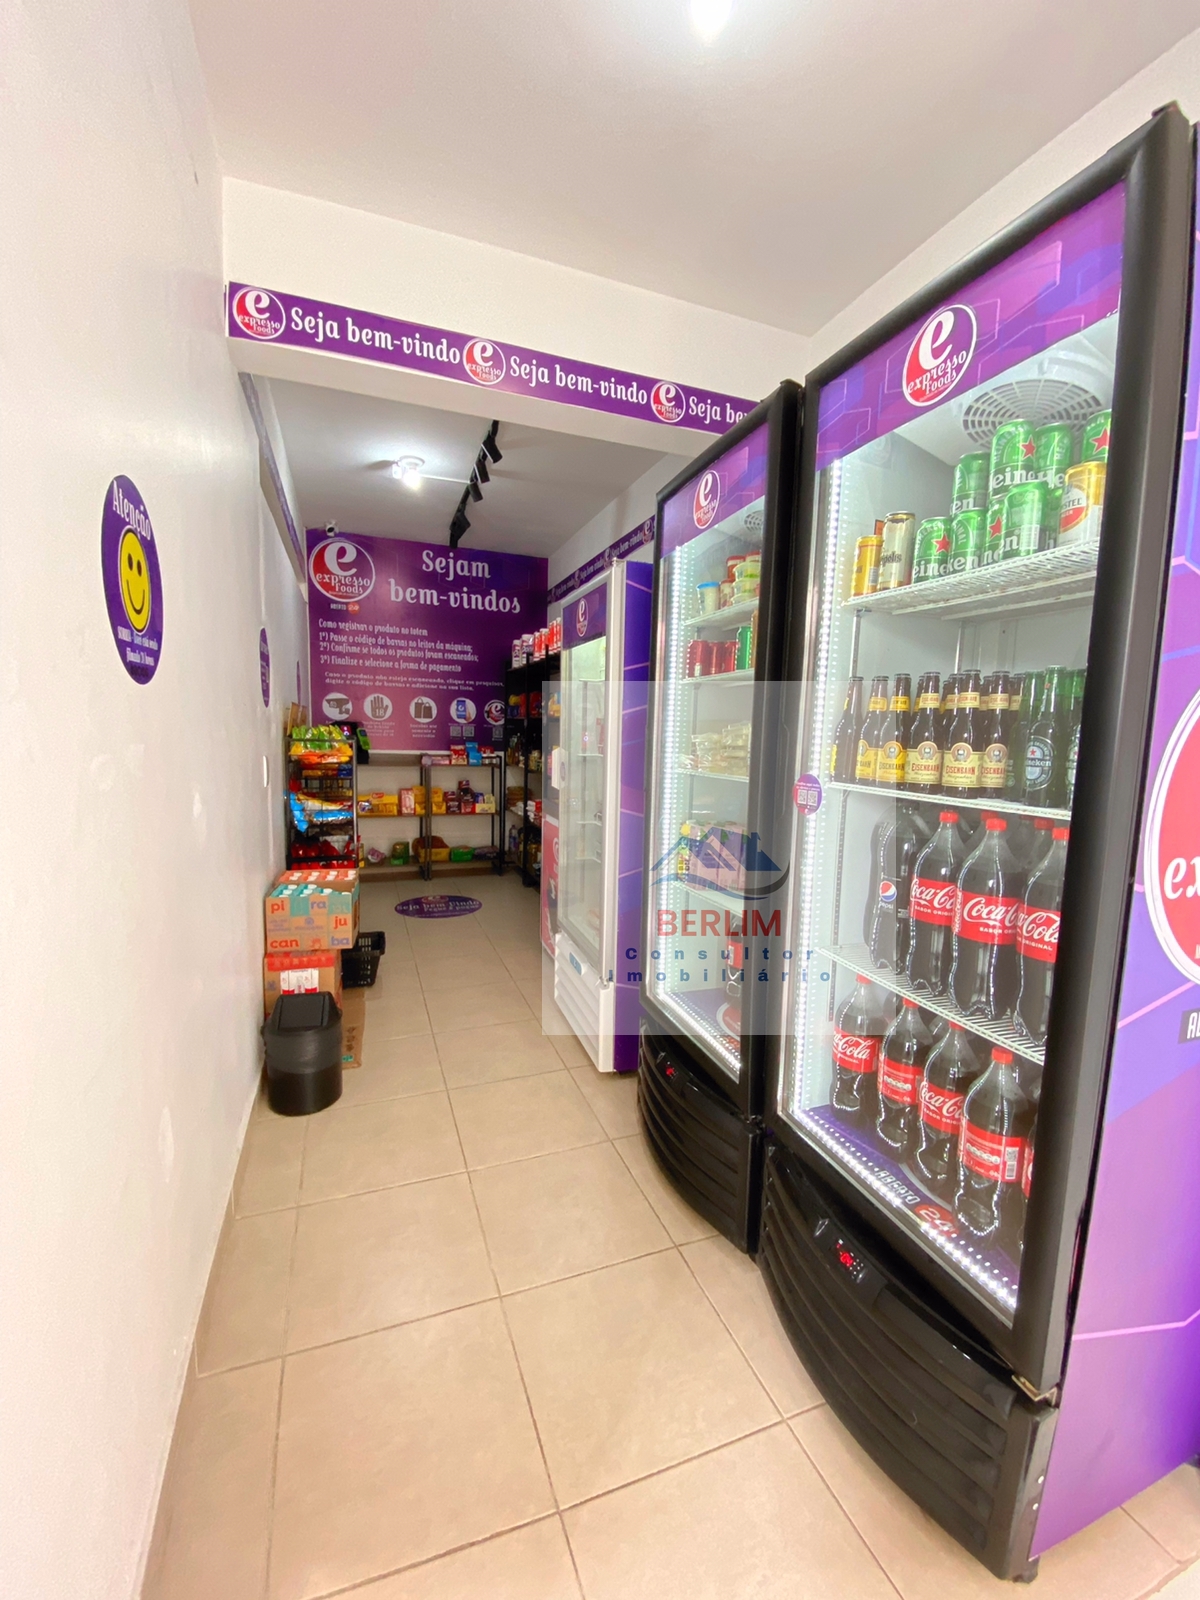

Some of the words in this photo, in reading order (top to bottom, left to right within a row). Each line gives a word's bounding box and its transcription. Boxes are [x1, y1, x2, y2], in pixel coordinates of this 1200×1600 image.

[239, 314, 280, 330] expresso
[291, 307, 340, 343] Seja
[346, 317, 461, 364] bem-vindo
[510, 355, 550, 387] Seja
[555, 364, 647, 405] bem-vindo
[907, 350, 967, 393] expresso
[689, 396, 721, 424] Seja
[113, 480, 151, 540] Atenção
[422, 550, 491, 581] Sejam
[316, 573, 370, 587] expresso
[389, 578, 520, 613] bem-vindos
[319, 618, 337, 629] Como
[338, 621, 368, 632] registrar
[374, 624, 399, 635] produto
[410, 626, 428, 636] totem
[330, 632, 347, 642] Passe
[355, 634, 376, 646] código
[377, 636, 385, 645] de
[387, 636, 408, 647] barras
[409, 640, 417, 648] no
[418, 639, 435, 649] leitor
[436, 640, 444, 650] da
[331, 642, 360, 654] Confirme
[362, 646, 369, 654] se
[370, 646, 387, 656] todos
[388, 648, 395, 656] os
[396, 648, 424, 658] produtos
[425, 649, 443, 660] foram
[332, 655, 357, 666] Finalize
[364, 658, 393, 668] selecione
[400, 659, 419, 670] forma
[420, 661, 427, 670] de
[429, 662, 462, 673] pagamento
[945, 765, 975, 775] EISENBAHN
[270, 900, 285, 914] pi
[310, 900, 326, 909] ra
[333, 916, 347, 929] ju
[270, 938, 299, 949] can
[331, 936, 350, 946] ba
[875, 1170, 920, 1204] ABERTO
